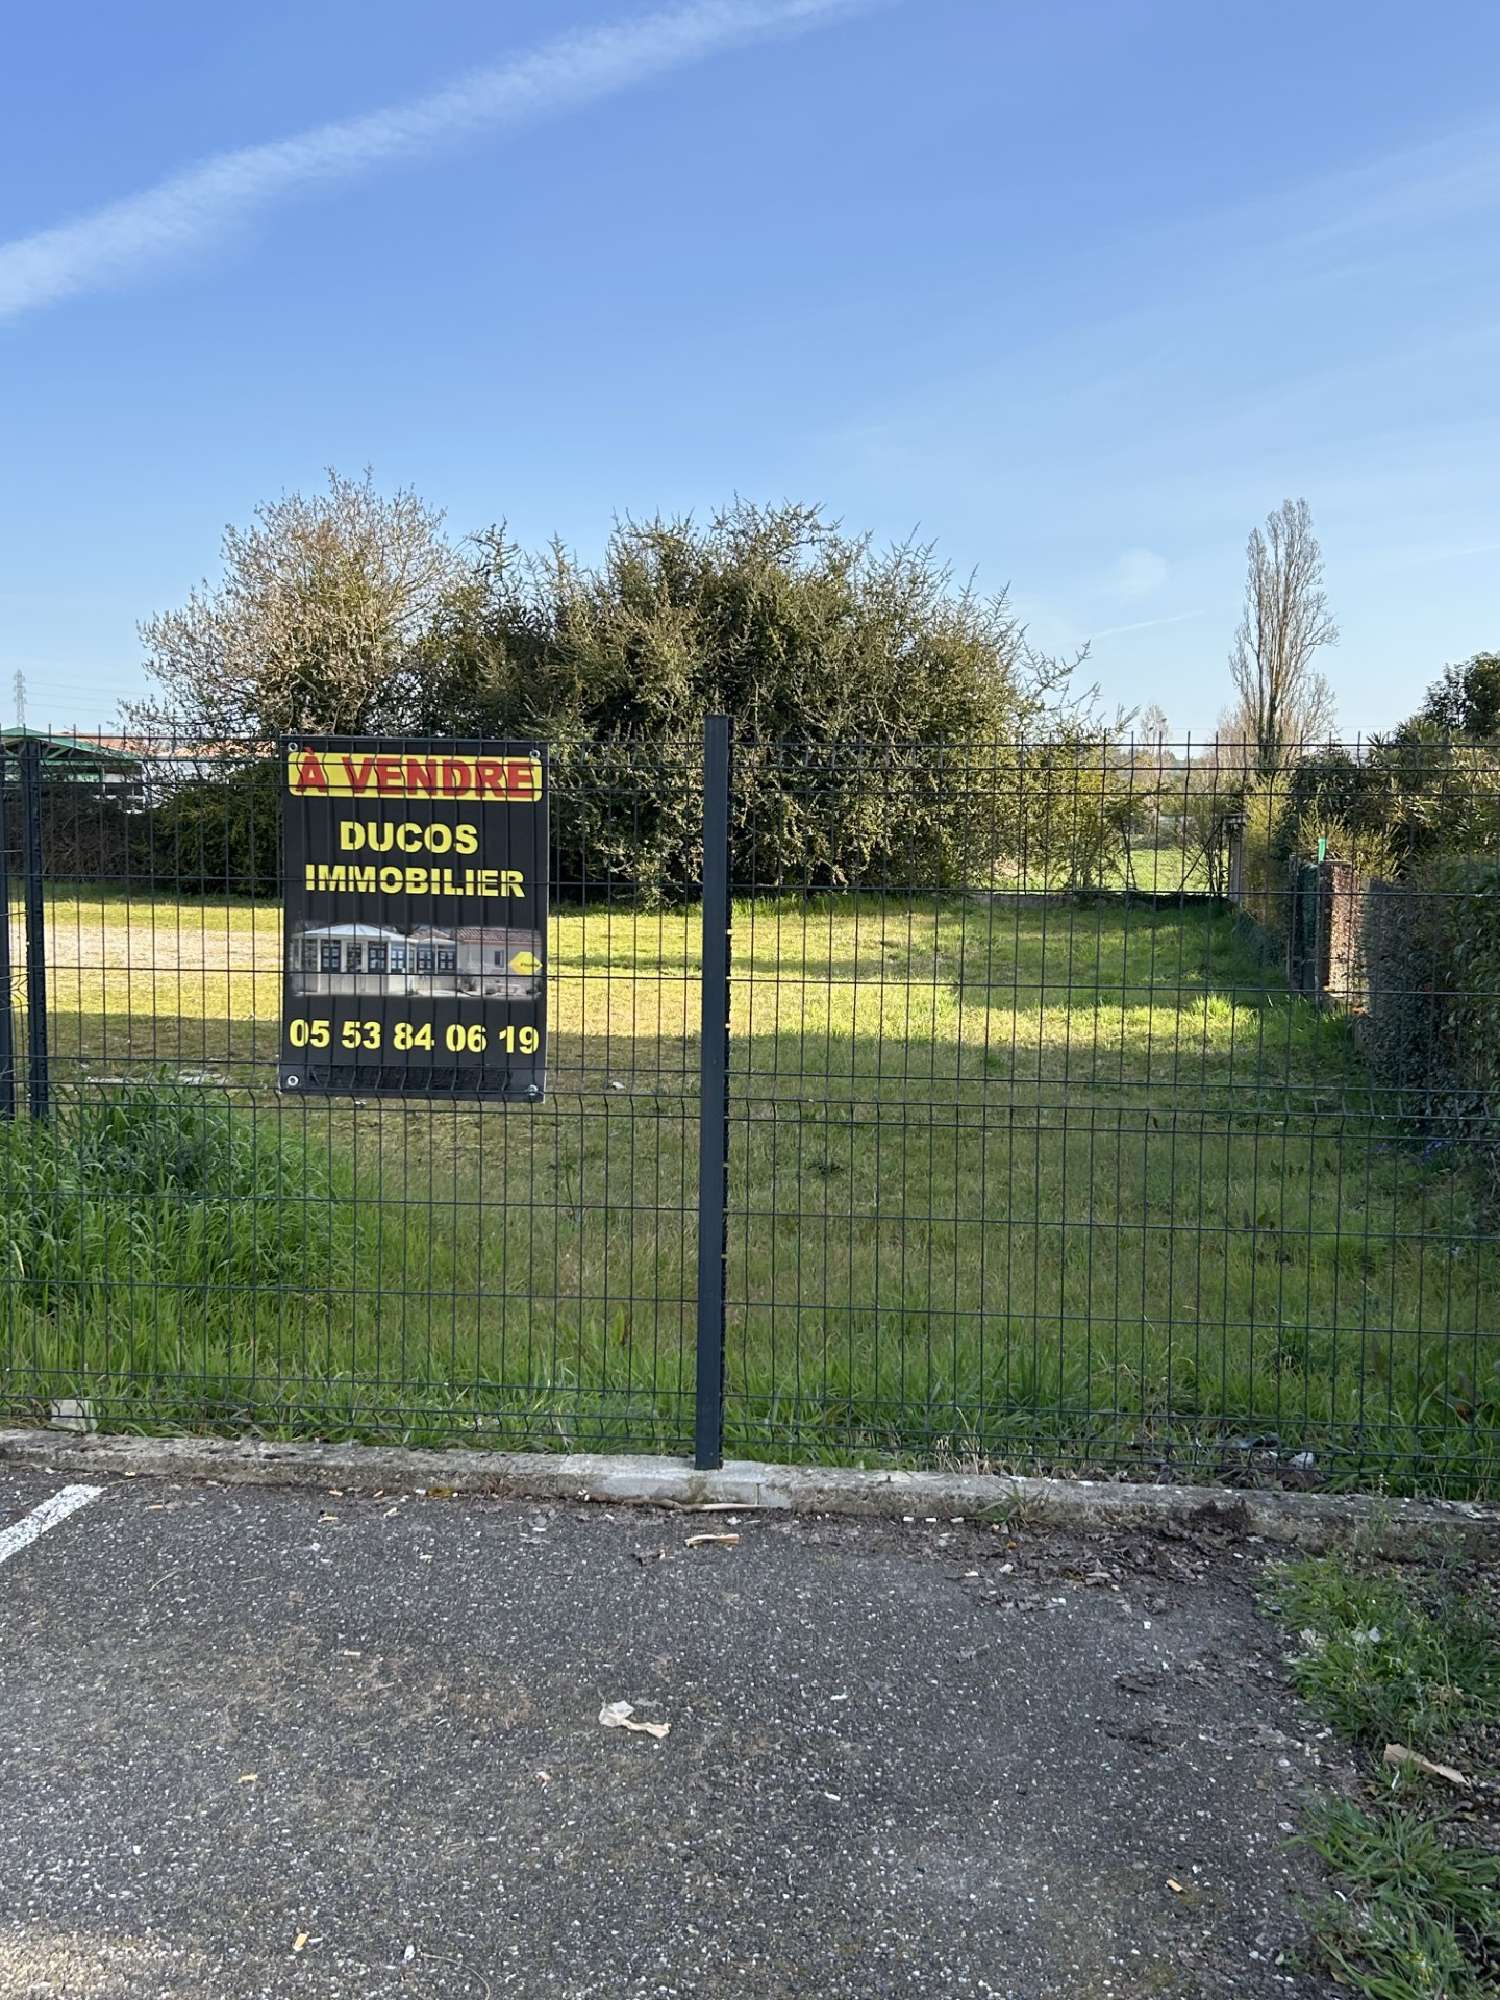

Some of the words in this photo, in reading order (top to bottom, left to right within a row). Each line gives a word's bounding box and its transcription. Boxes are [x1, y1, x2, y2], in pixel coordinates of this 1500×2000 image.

[296, 746, 327, 793] À
[341, 755, 534, 798] VENDRE
[340, 821, 478, 854] DUCOS
[305, 864, 525, 897] IMMOBILIER
[289, 1019, 330, 1048] 05
[341, 1021, 381, 1049] 53
[393, 1023, 434, 1050] 84
[446, 1024, 486, 1052] 06
[499, 1025, 539, 1053] 19
